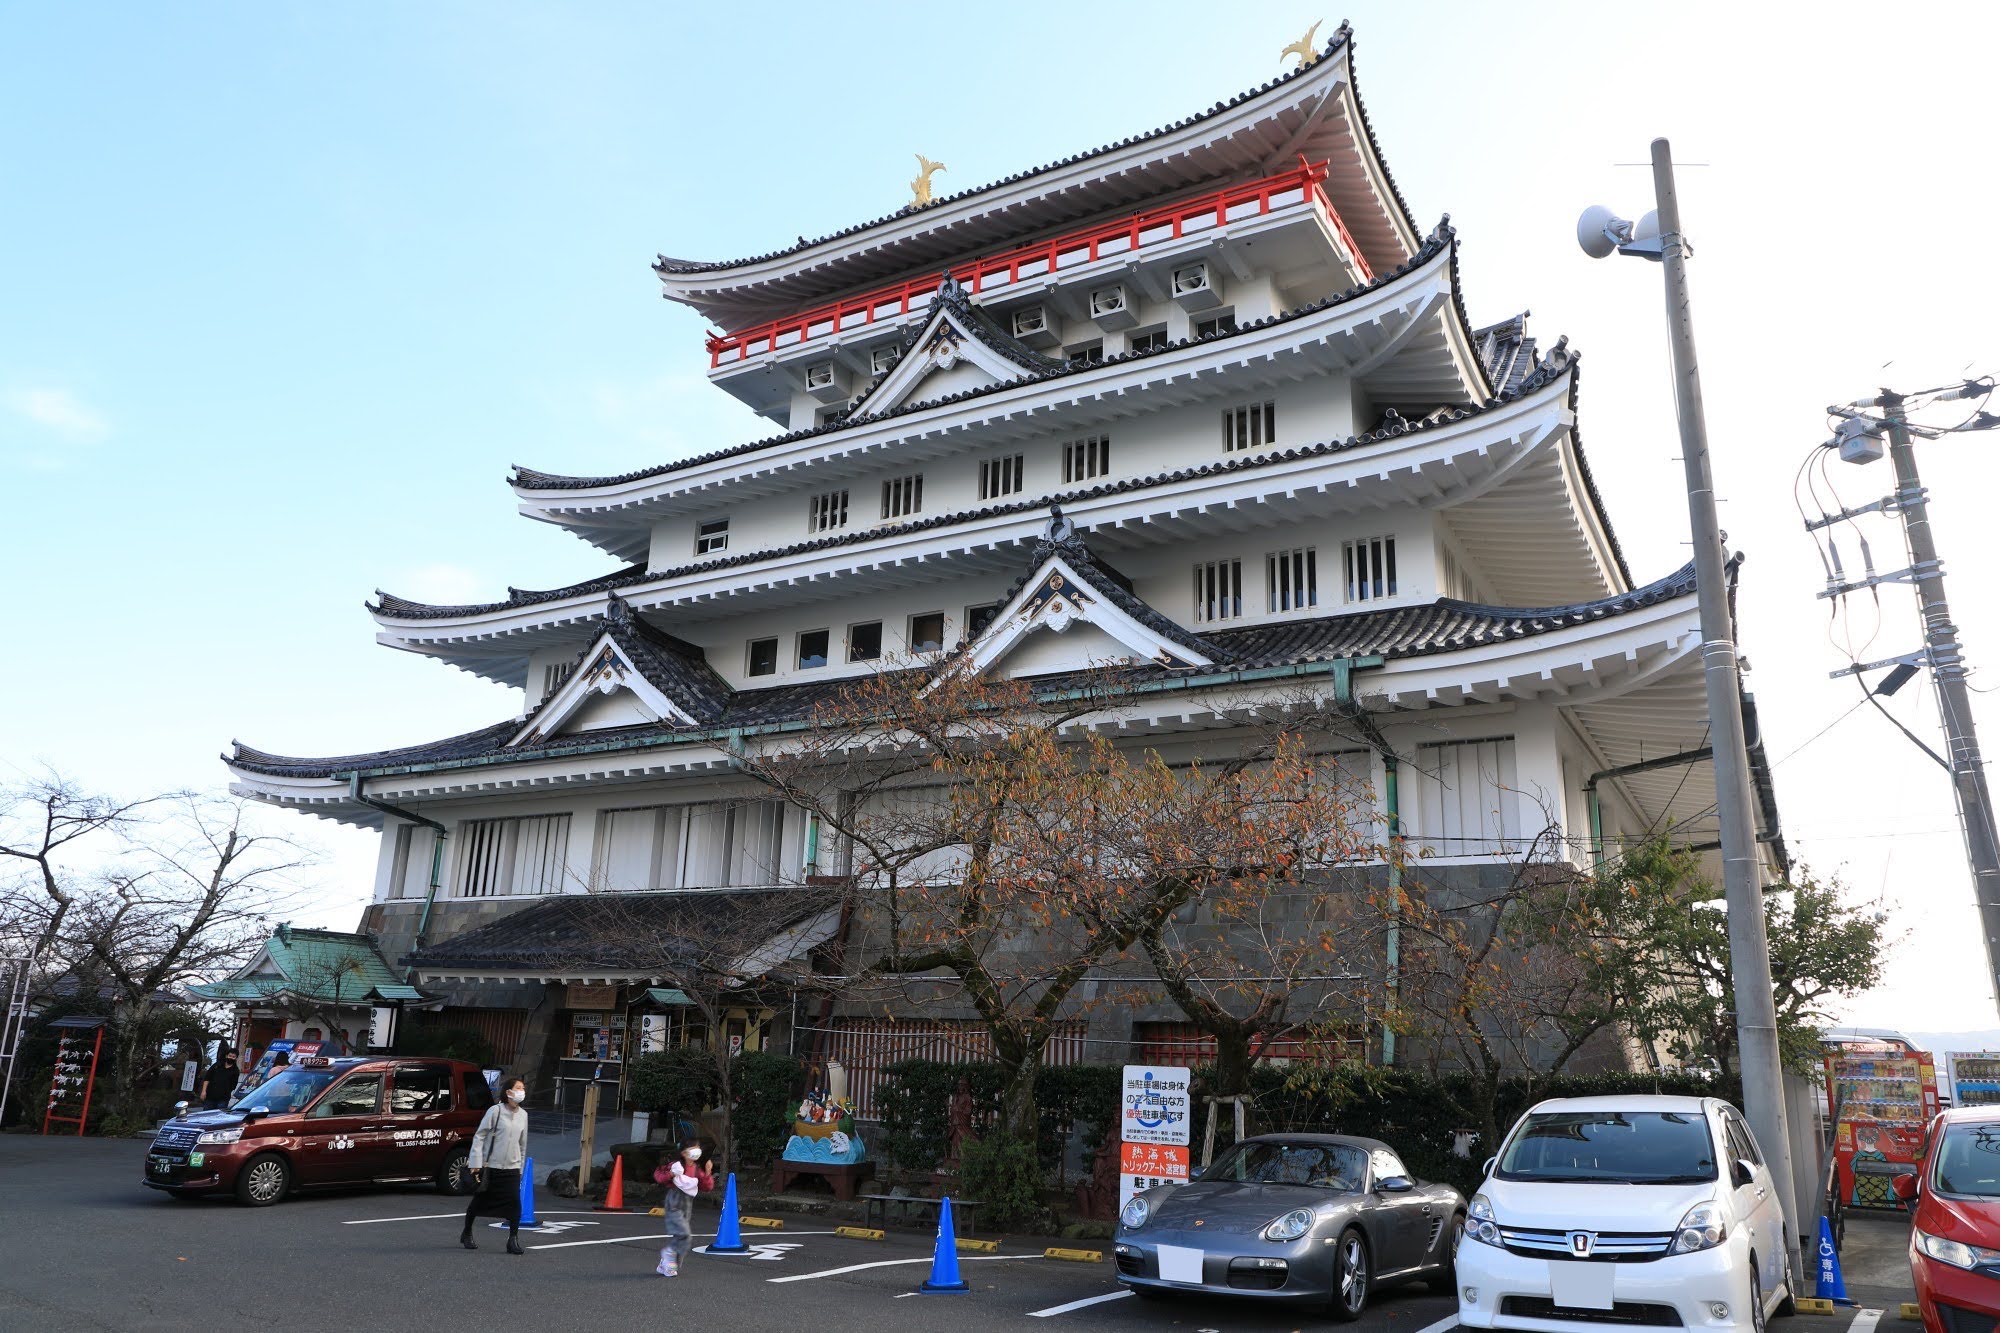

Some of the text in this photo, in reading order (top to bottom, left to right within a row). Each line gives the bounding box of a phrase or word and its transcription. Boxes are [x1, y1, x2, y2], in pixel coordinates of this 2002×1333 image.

[1127, 1080, 1186, 1091] 当駐車場は身体
[1126, 1094, 1185, 1106] のご不自由な方
[1126, 1109, 1184, 1121] 優先駐車場です
[394, 1129, 442, 1140] OGATA TAXI
[1132, 1146, 1178, 1161] 熱海城
[1123, 1160, 1187, 1175] トリックアート迷宮館
[1821, 1259, 1834, 1283] 専用
